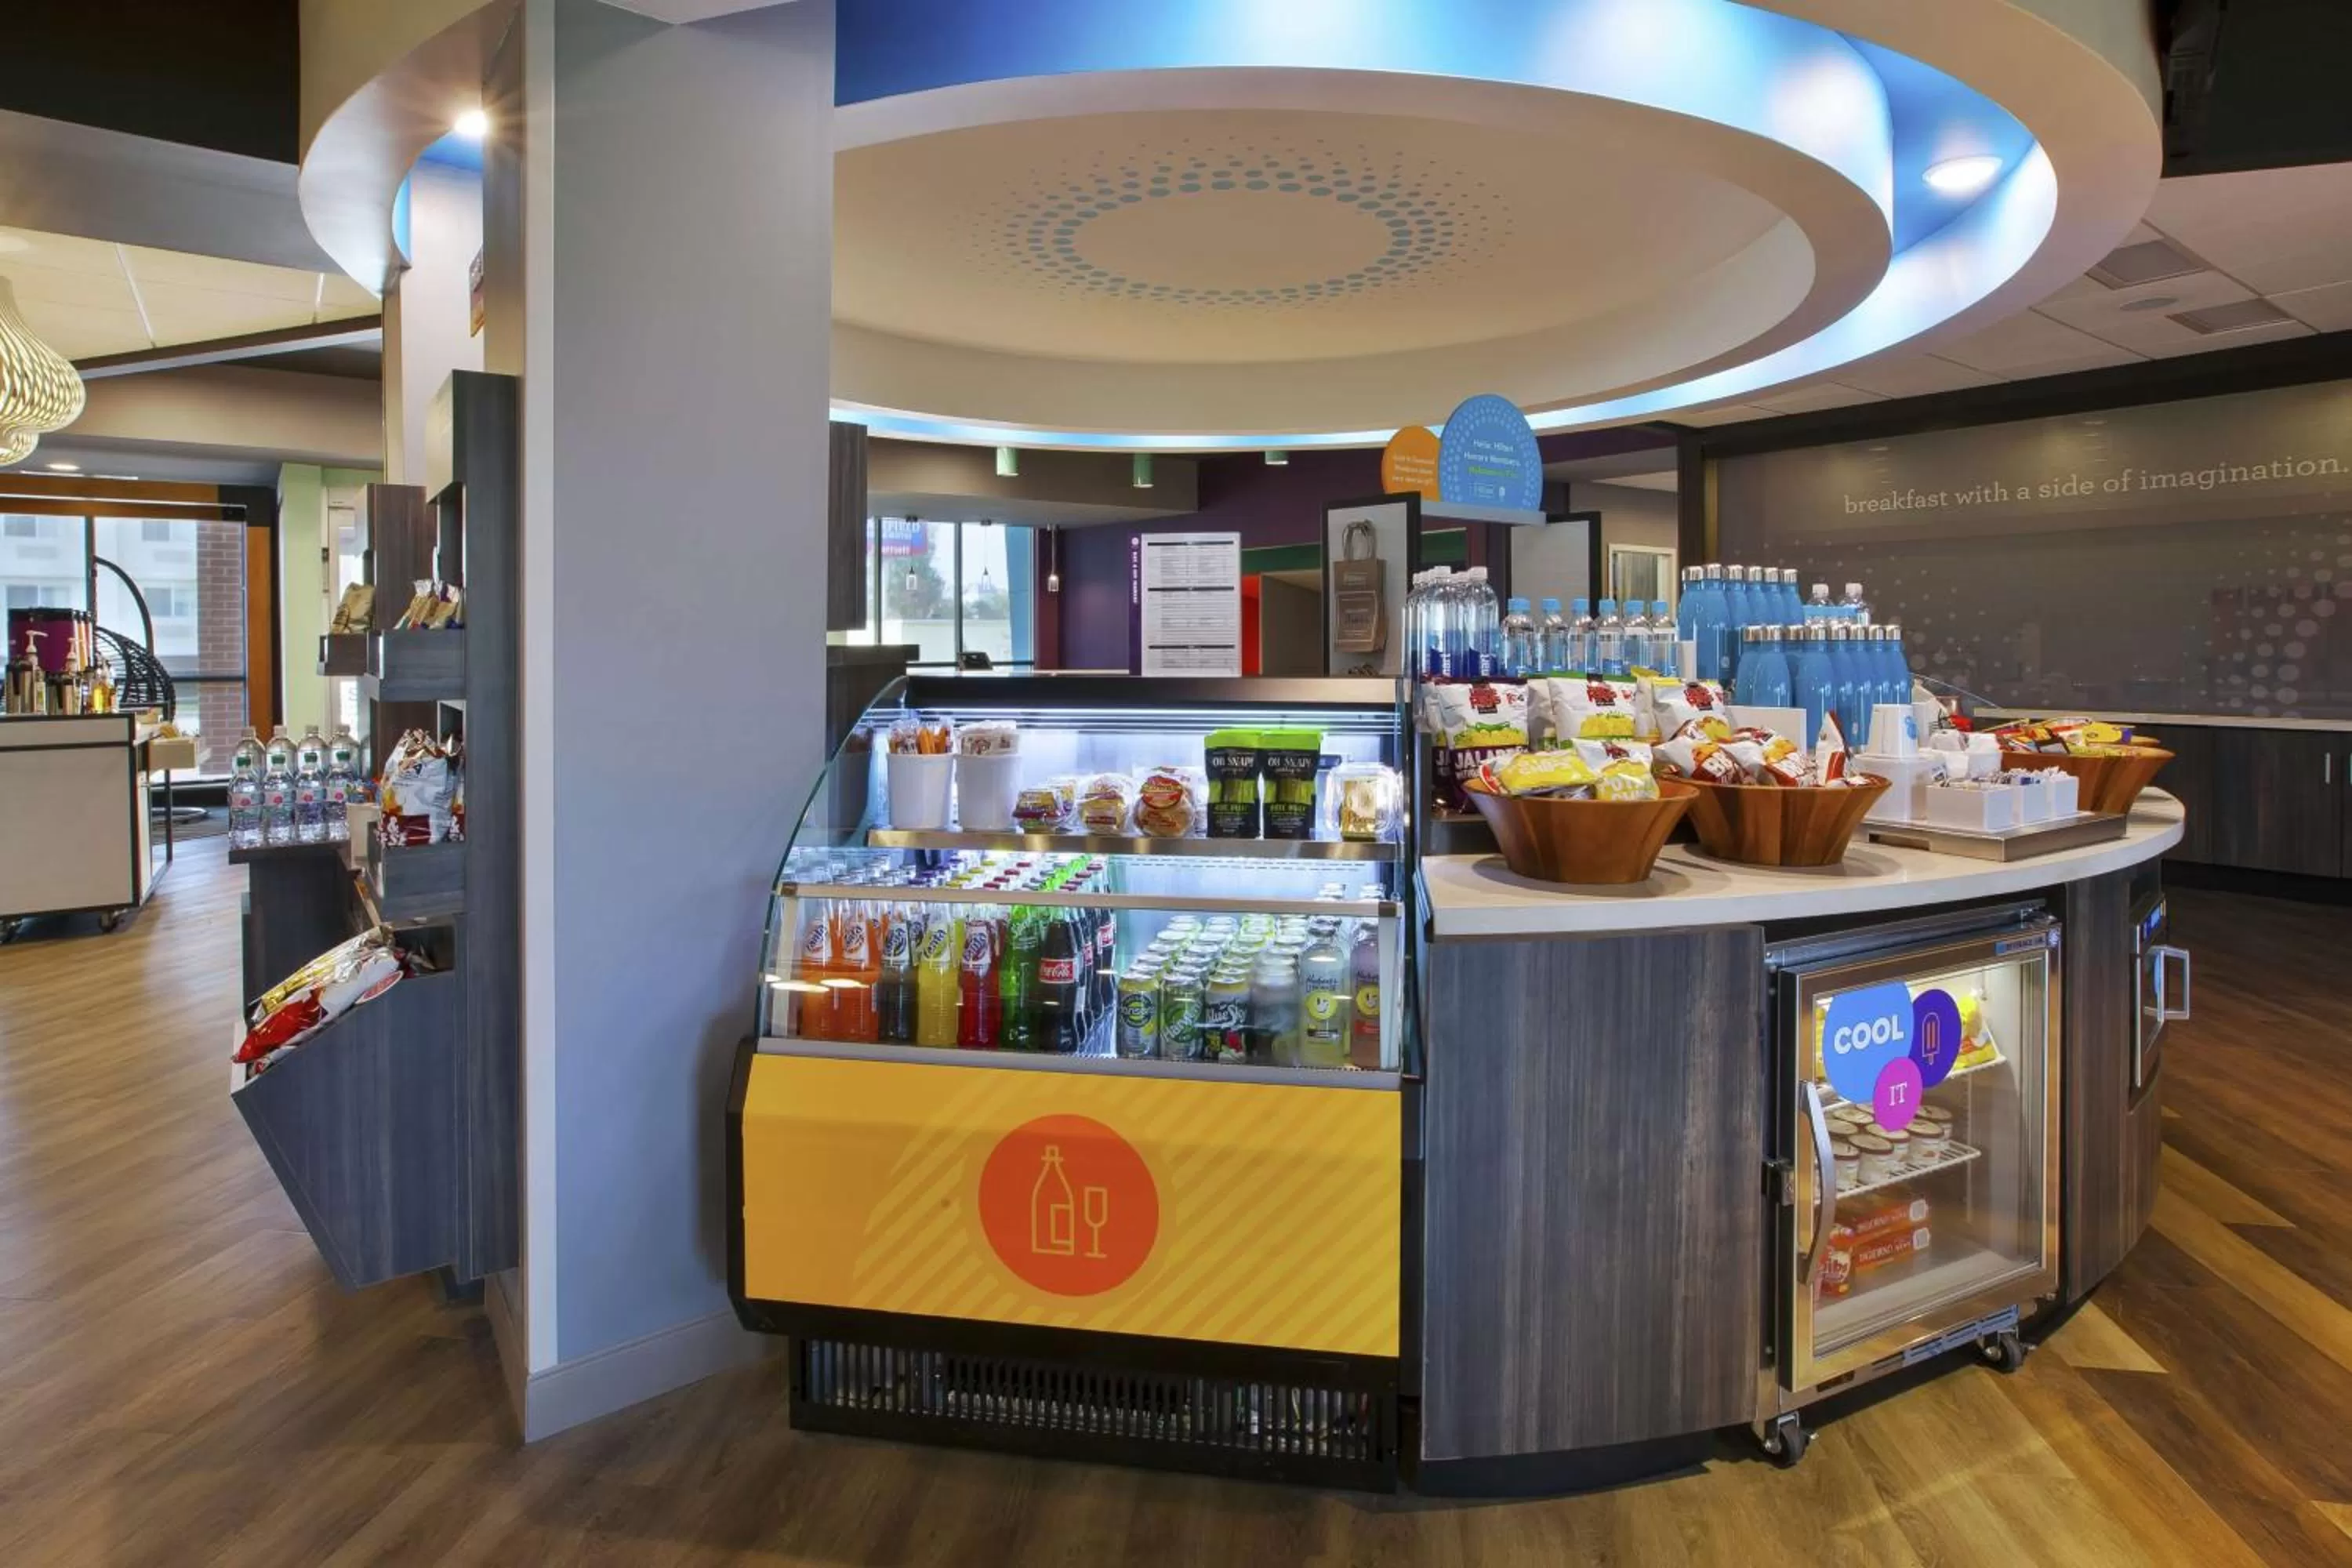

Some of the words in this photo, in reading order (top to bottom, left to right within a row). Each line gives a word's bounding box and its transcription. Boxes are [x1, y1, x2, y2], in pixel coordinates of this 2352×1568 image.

[1844, 489, 1948, 514] breakfast
[1955, 481, 2008, 505] with
[2016, 486, 2031, 500] a
[2039, 474, 2094, 498] side
[2103, 469, 2132, 493] of
[2139, 456, 2350, 491] imagination.
[1835, 1014, 1904, 1054] COOL
[1889, 1081, 1907, 1106] IT
